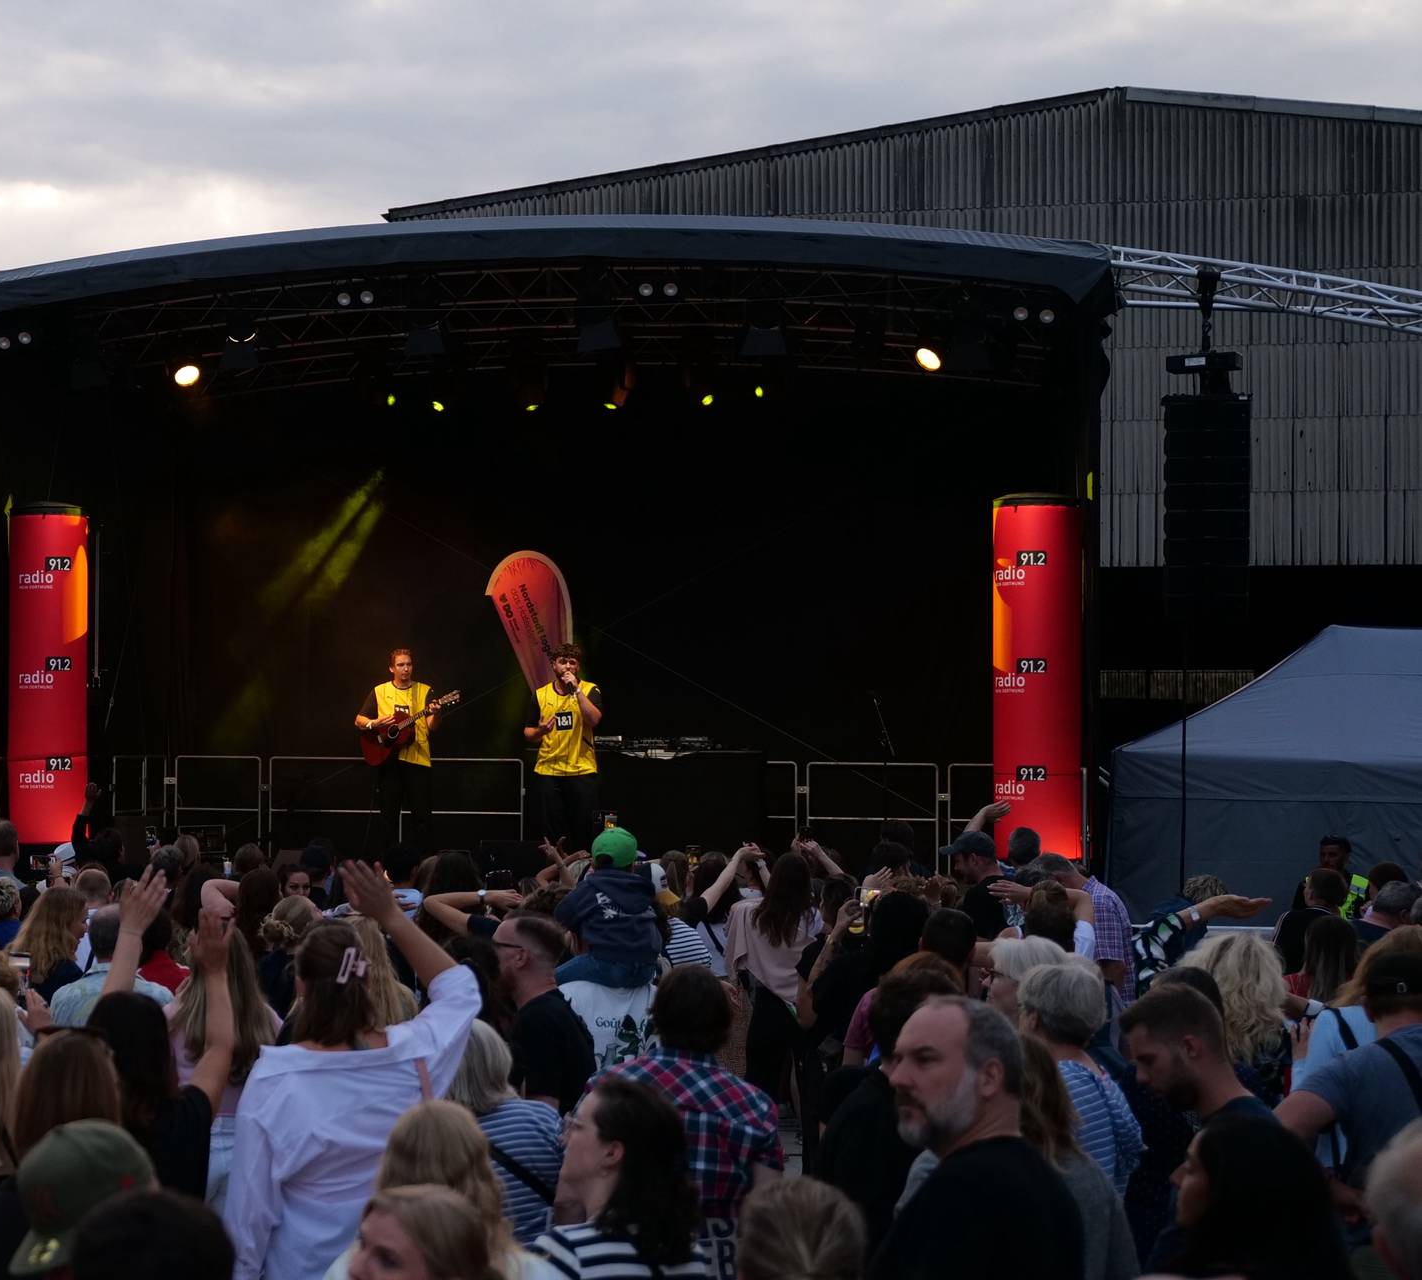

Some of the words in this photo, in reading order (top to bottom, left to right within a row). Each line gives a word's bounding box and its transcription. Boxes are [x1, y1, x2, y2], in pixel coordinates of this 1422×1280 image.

[49, 558, 71, 571] 91.2
[1020, 552, 1046, 566] 91.2
[18, 570, 54, 584] radio
[995, 566, 1026, 581] radio
[49, 658, 71, 671] 91.2
[1020, 660, 1046, 673] 91.2
[19, 670, 54, 684] radio
[995, 673, 1026, 688] radio
[49, 758, 72, 771] 91.2
[19, 770, 55, 784] radio
[1020, 767, 1046, 781] 91.2
[995, 780, 1026, 795] radio
